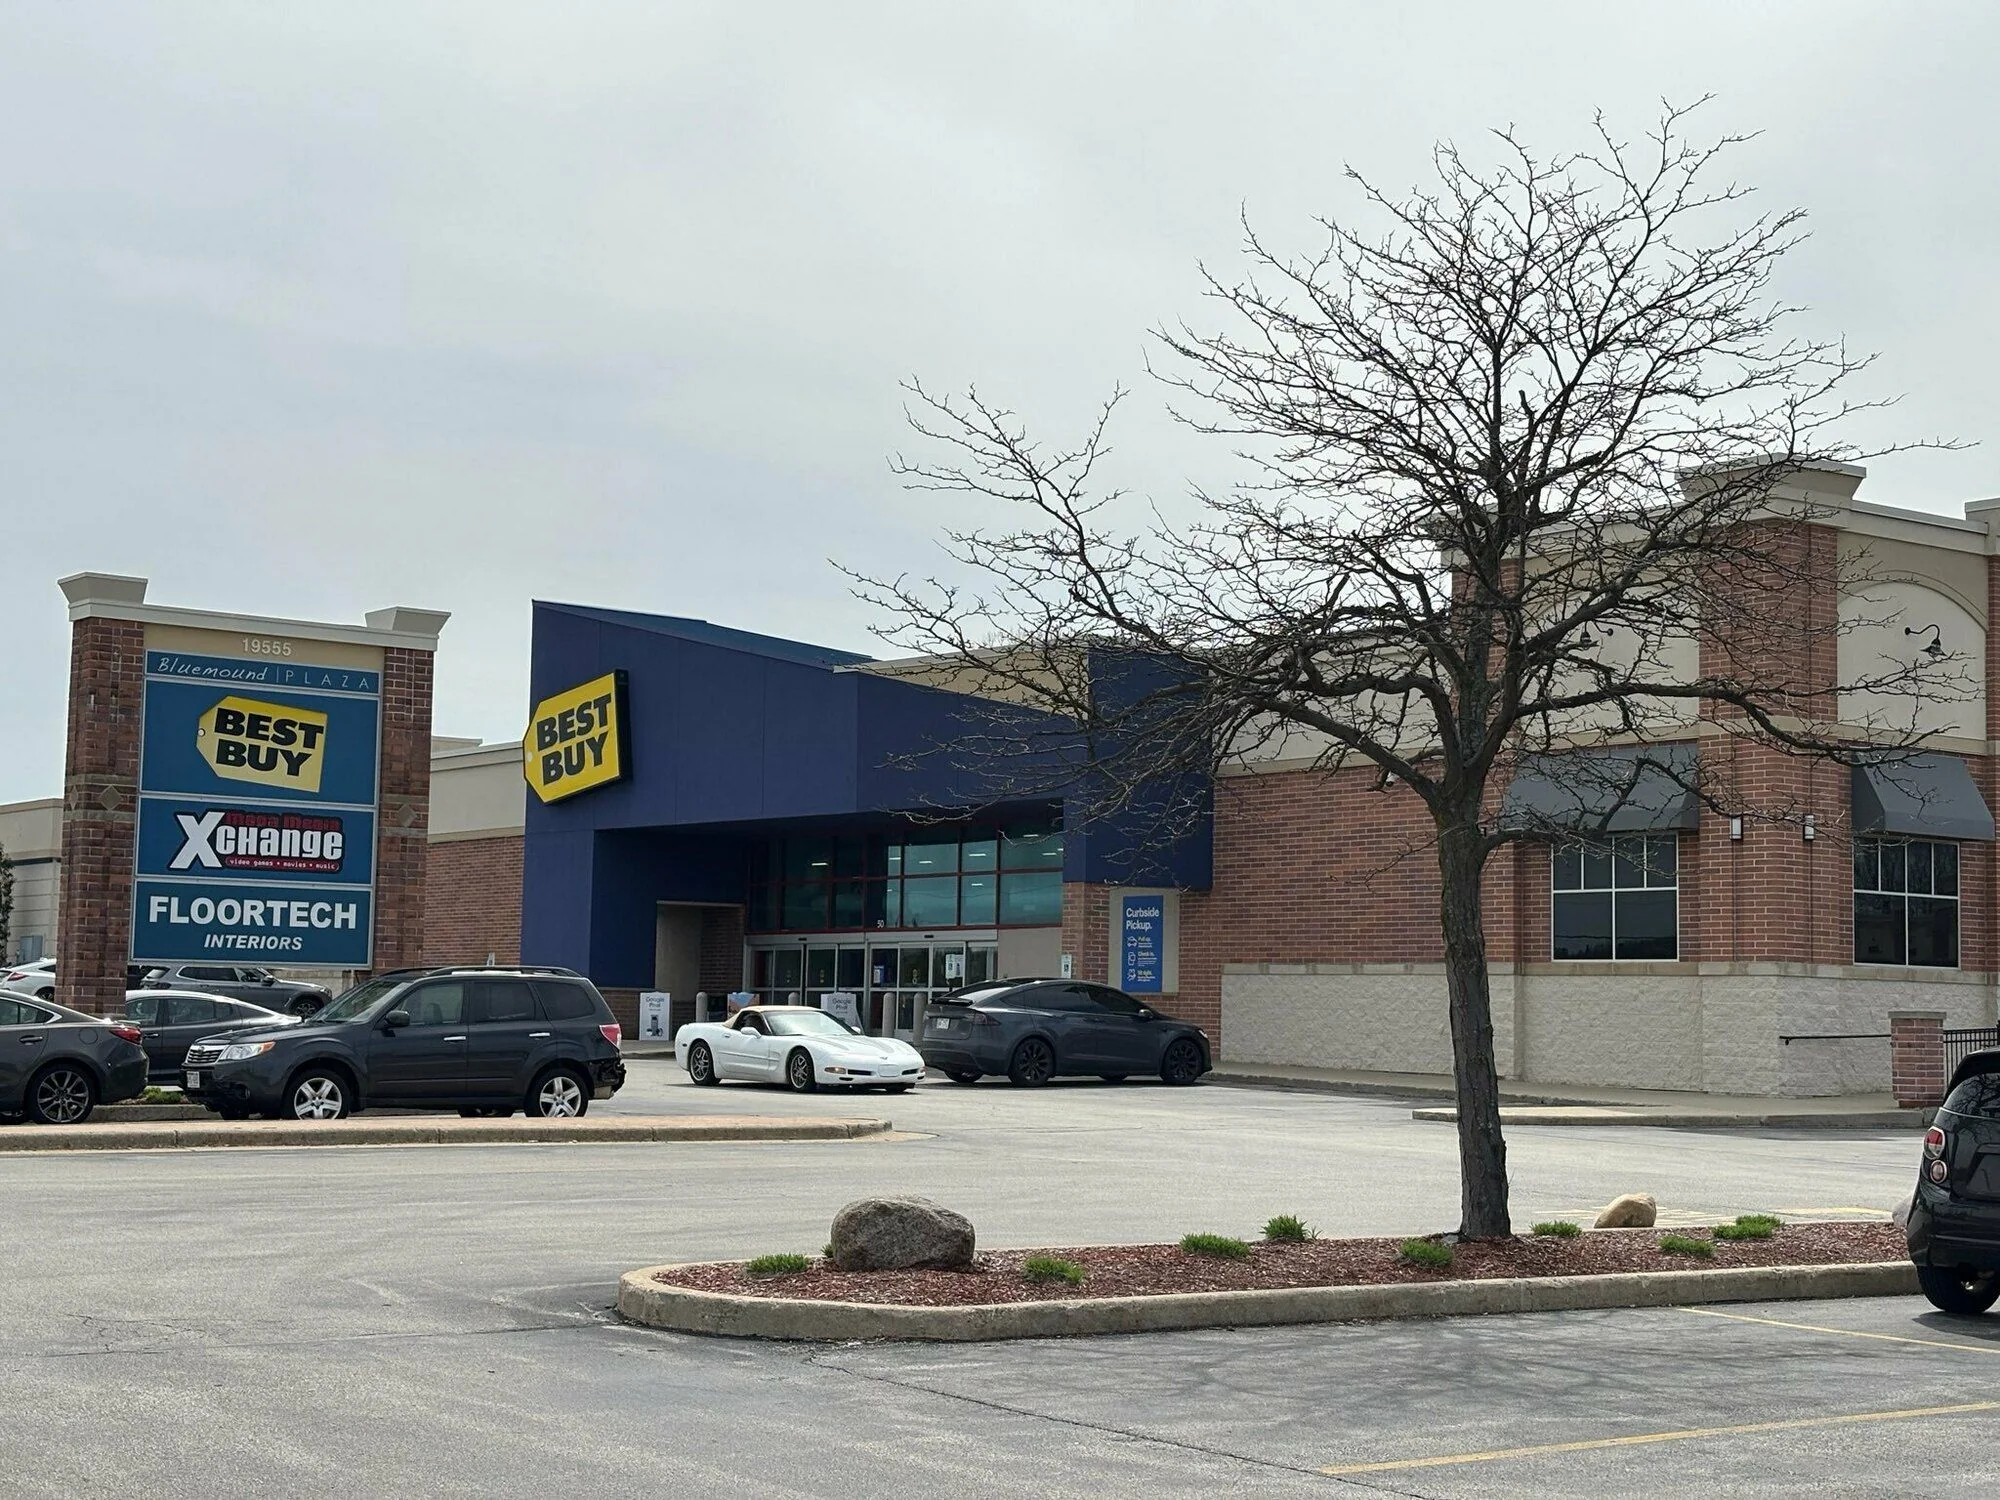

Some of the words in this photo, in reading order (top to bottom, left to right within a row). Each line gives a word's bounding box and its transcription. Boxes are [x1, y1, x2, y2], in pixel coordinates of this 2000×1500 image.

[242, 637, 292, 657] 19555
[157, 657, 269, 681] Bluemound
[285, 669, 369, 690] PLAZA
[214, 707, 325, 750] BEST
[536, 692, 612, 752] BEST
[215, 738, 313, 777] BUY
[542, 730, 609, 787] BUY
[149, 895, 357, 930] FLOORTECH
[1126, 907, 1160, 918] Curbside
[1126, 920, 1153, 932] Pickup.
[203, 934, 303, 951] INTERIORS
